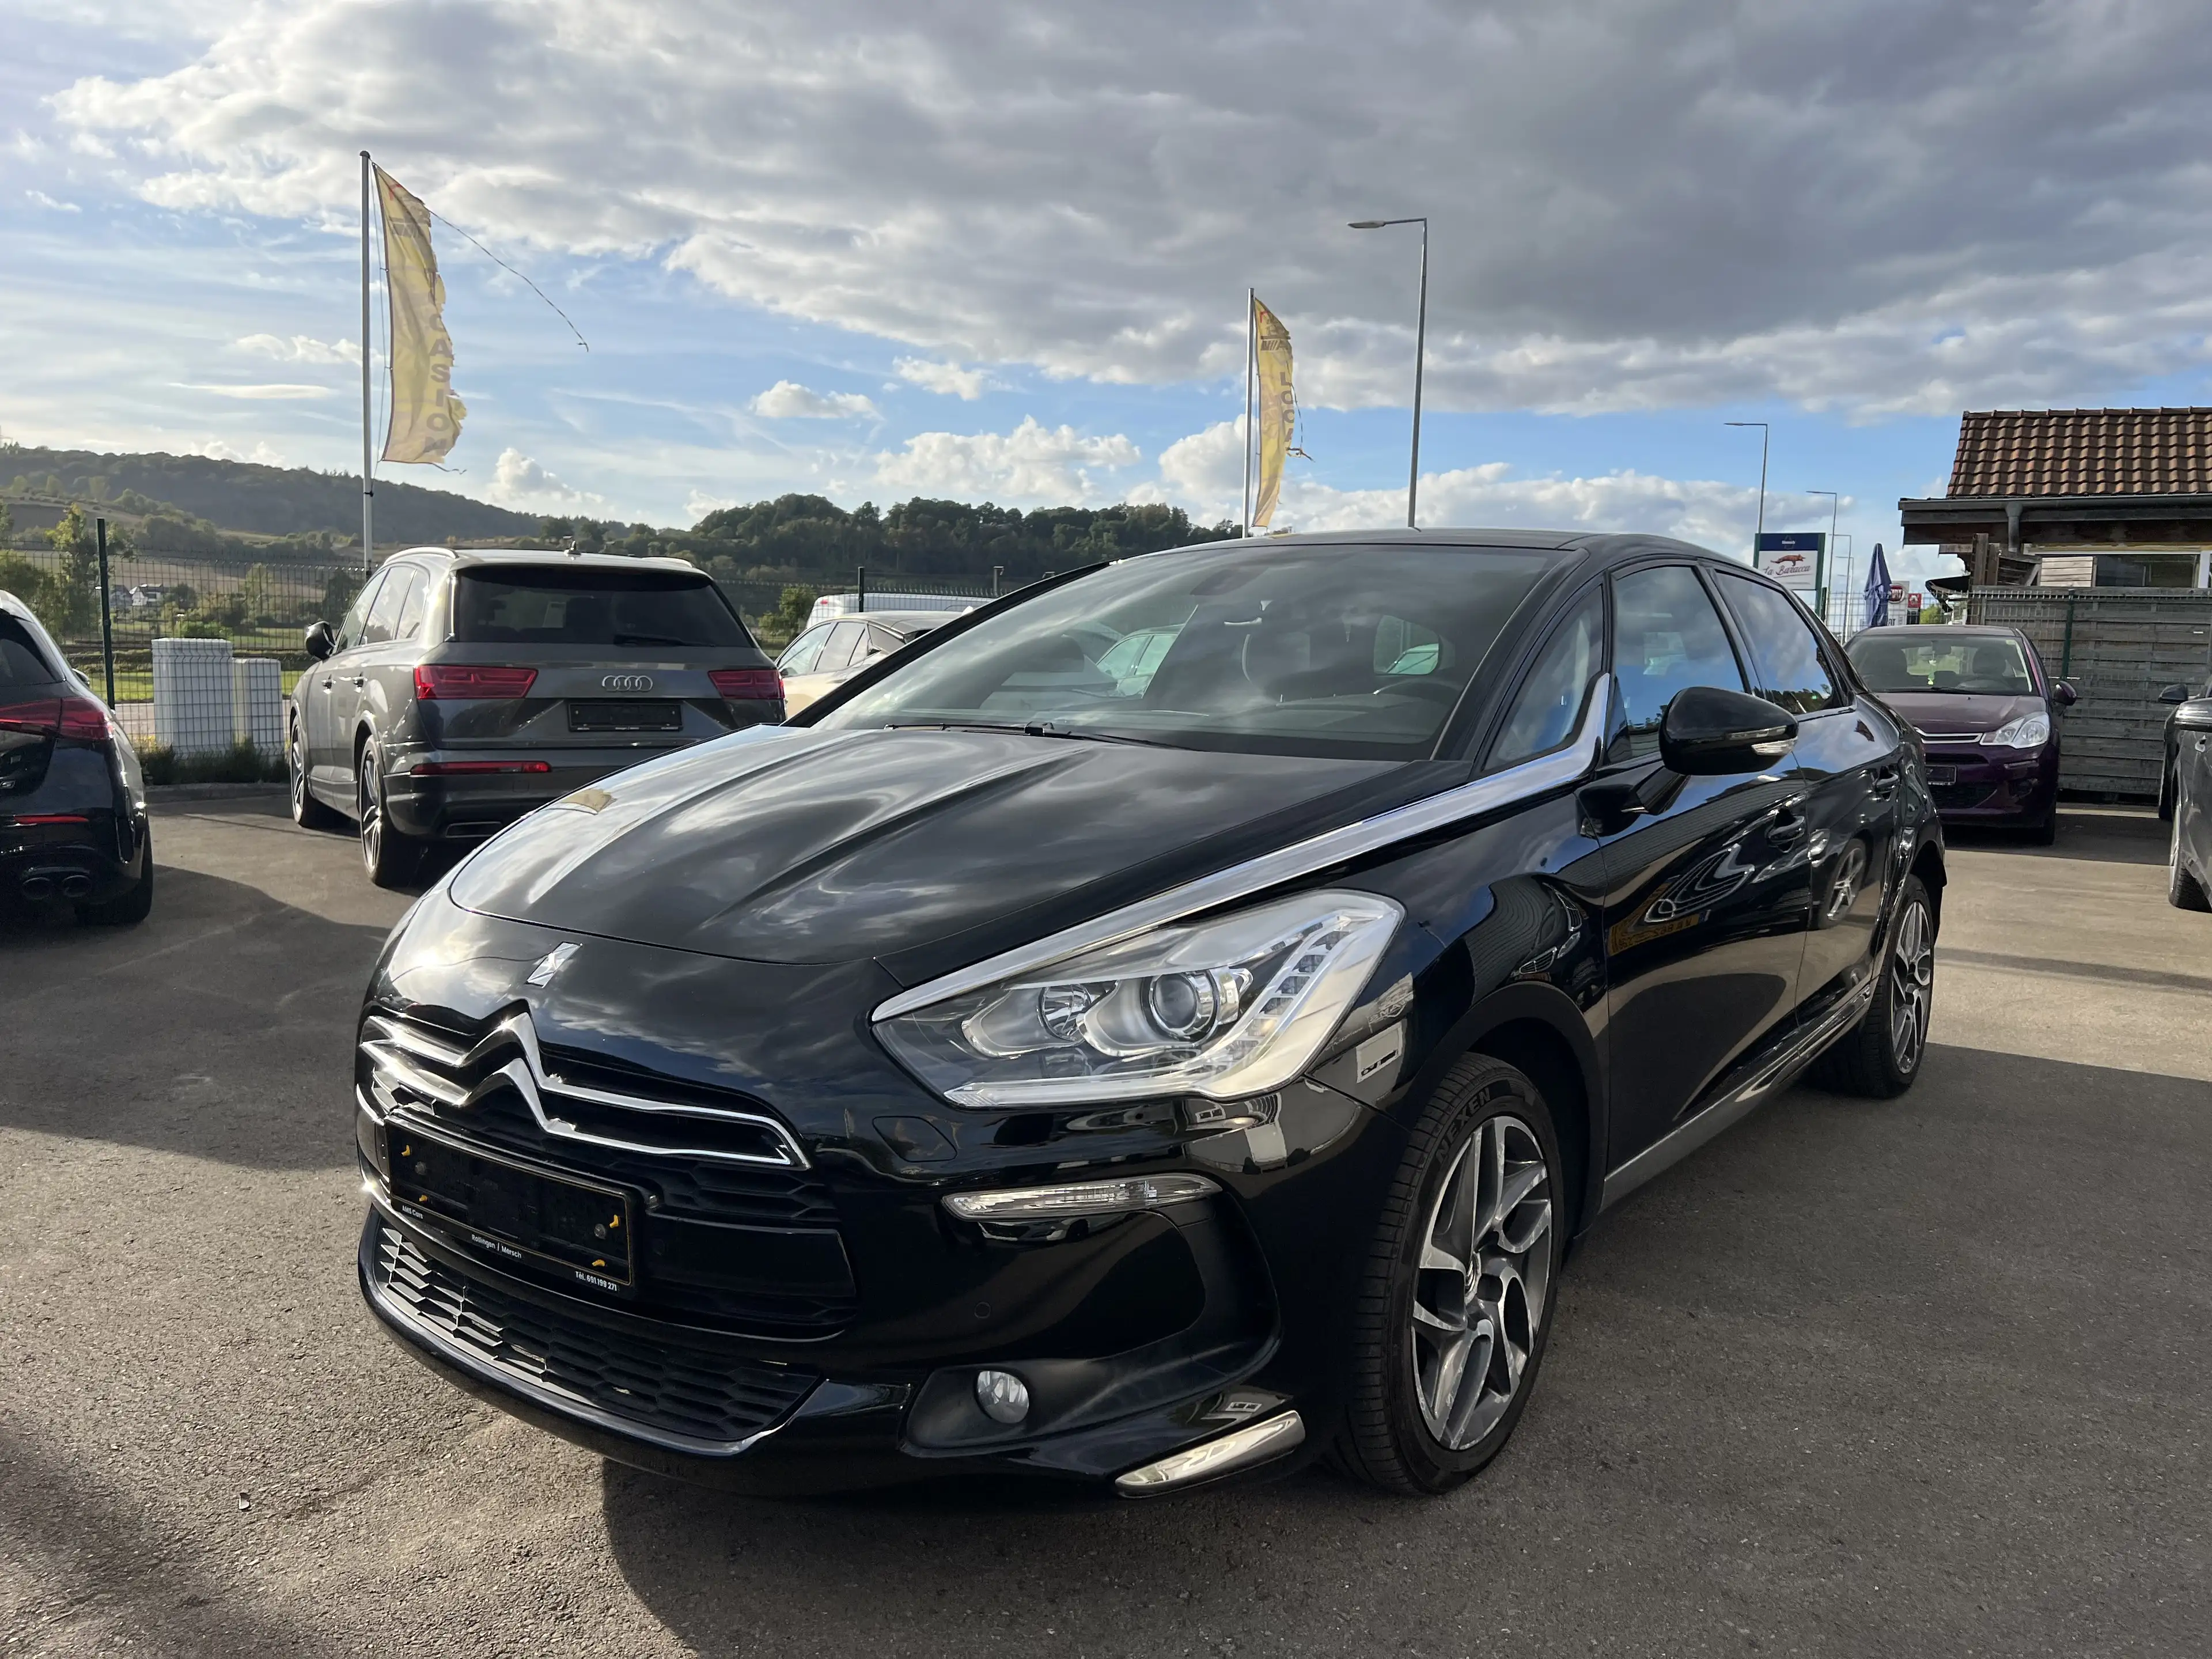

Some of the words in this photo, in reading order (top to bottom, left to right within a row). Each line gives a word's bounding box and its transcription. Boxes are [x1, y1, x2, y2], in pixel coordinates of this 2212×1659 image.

[1775, 565, 1810, 575] Baracca
[1436, 1087, 1491, 1162] NEXEN
[501, 1245, 521, 1259] Mersch
